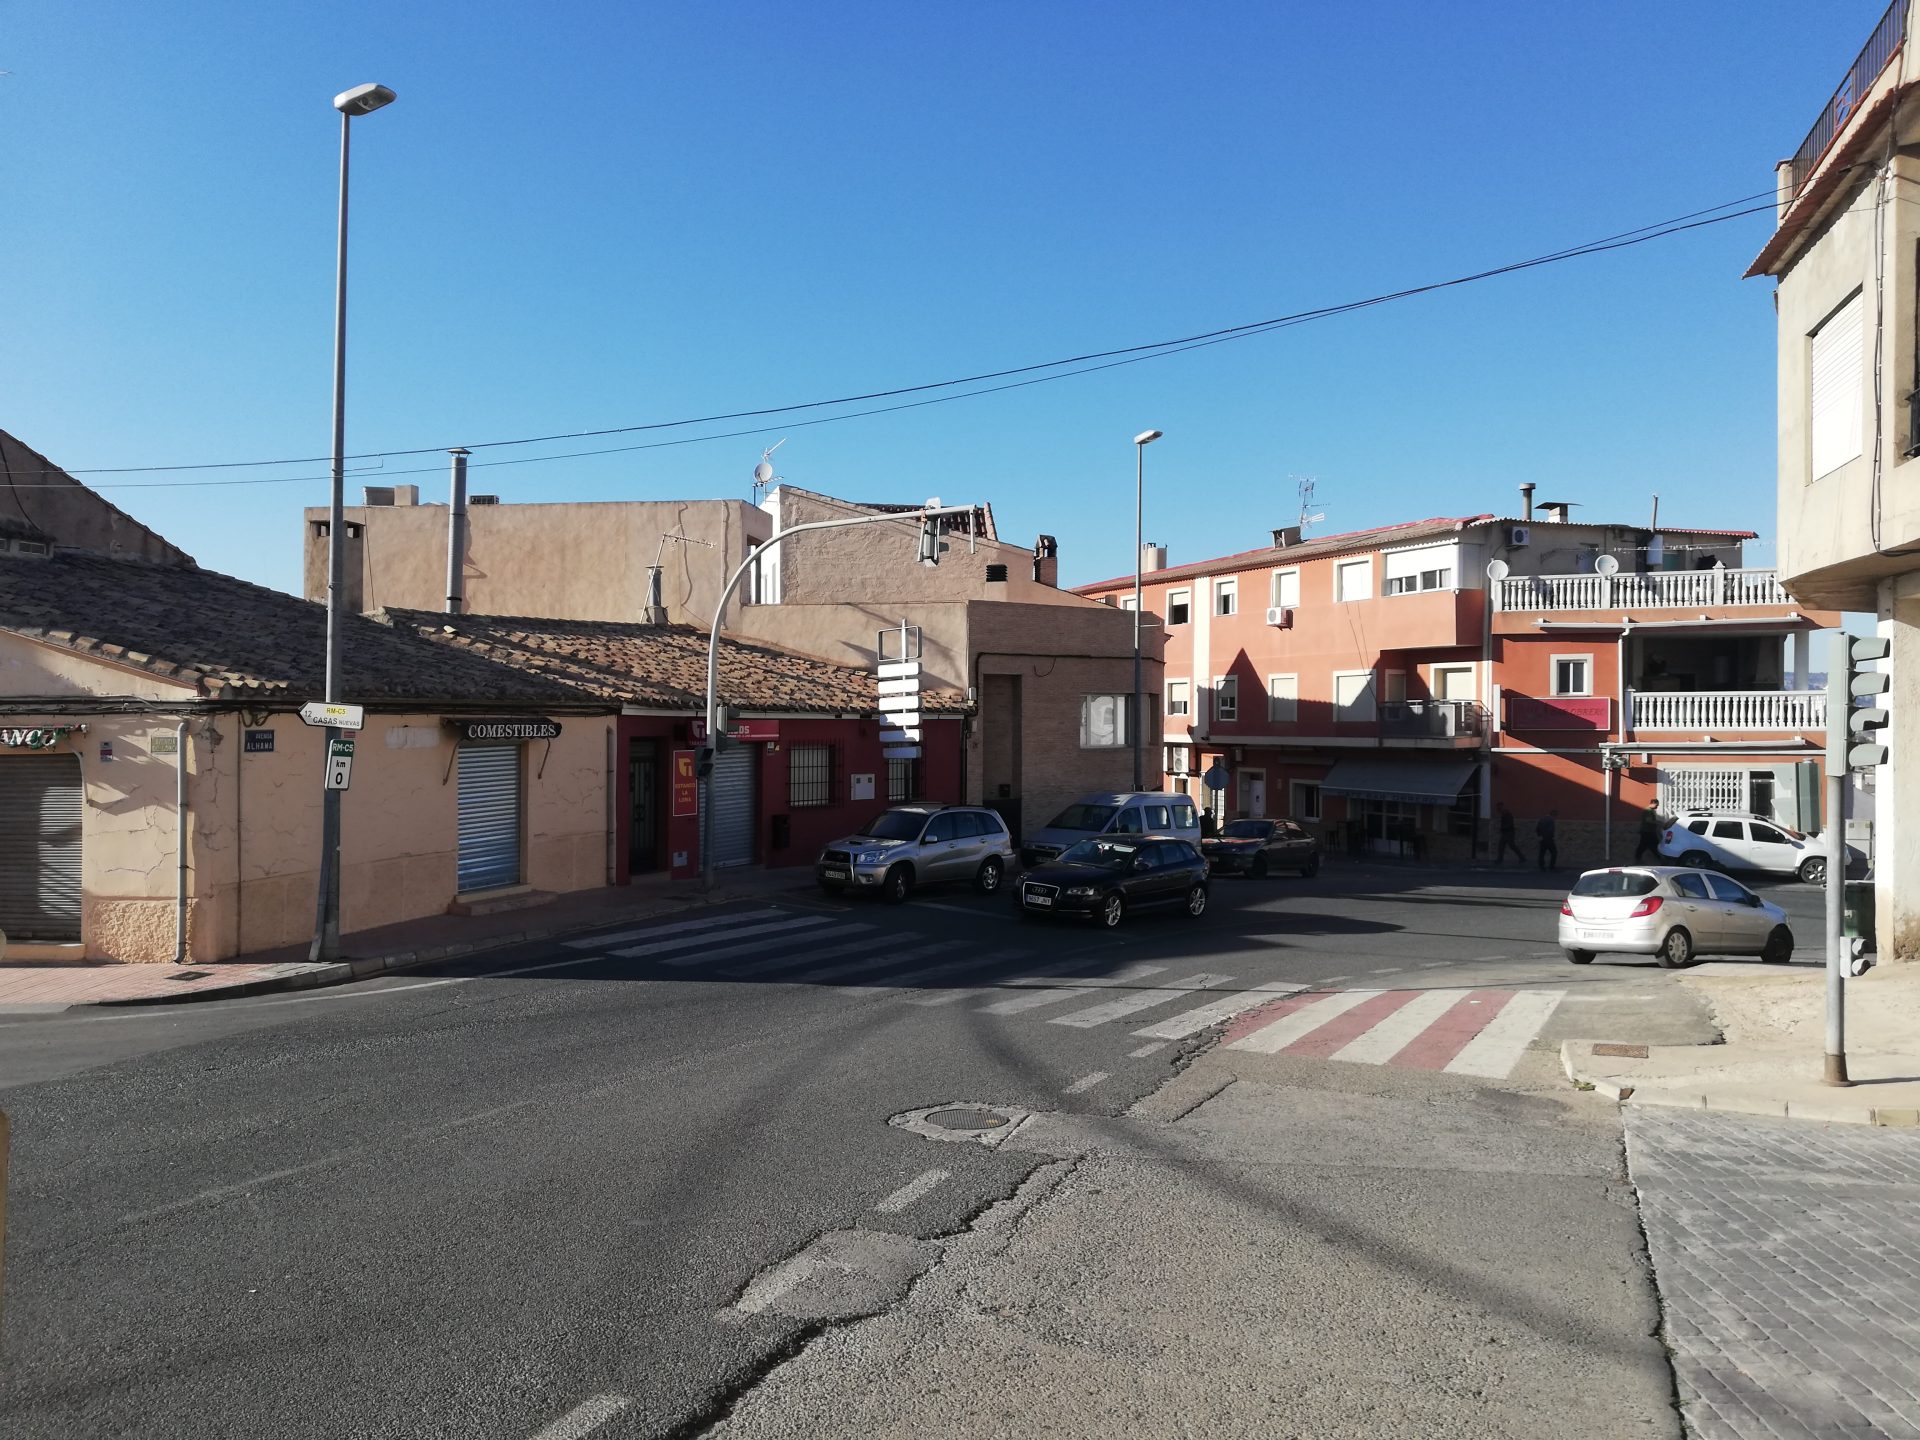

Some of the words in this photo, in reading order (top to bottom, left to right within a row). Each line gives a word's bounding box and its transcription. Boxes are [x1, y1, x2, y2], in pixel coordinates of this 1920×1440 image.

[326, 707, 346, 715] RM-C5
[304, 710, 312, 718] 12
[312, 716, 338, 725] CASAS
[468, 724, 557, 738] COMESTIBLES
[246, 741, 273, 750] ALHAMA
[332, 743, 354, 752] RM-C5
[336, 760, 346, 768] km
[335, 772, 343, 785] 0
